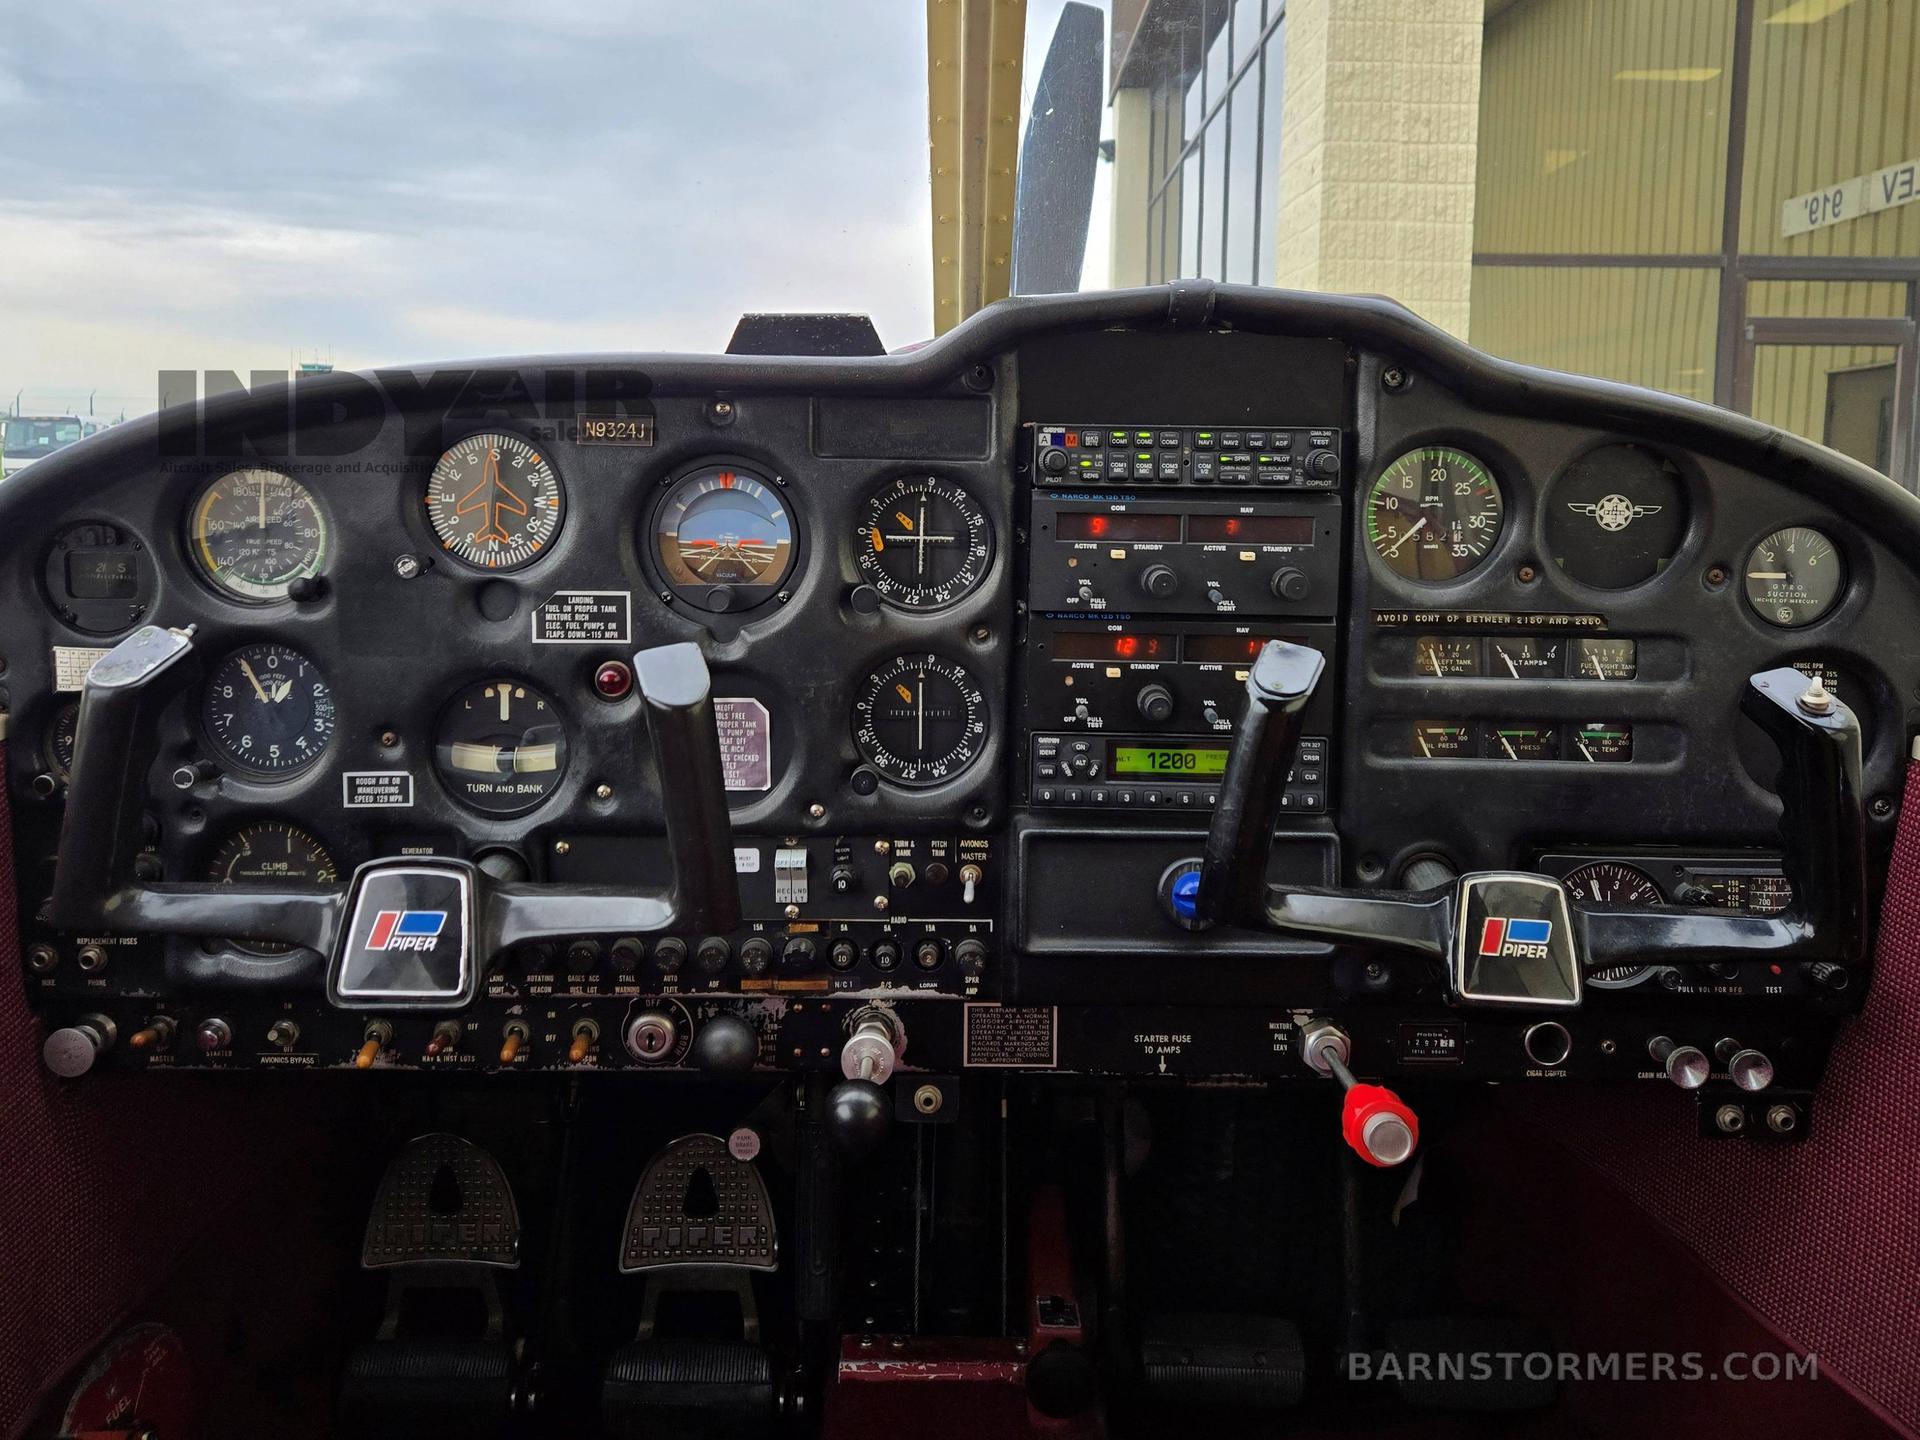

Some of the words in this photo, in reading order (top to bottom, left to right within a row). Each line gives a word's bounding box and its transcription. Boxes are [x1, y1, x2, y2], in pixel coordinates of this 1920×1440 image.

[585, 422, 645, 439] N9324J
[467, 453, 478, 466] 15
[490, 449, 501, 461] S
[511, 456, 525, 468] 21
[449, 468, 462, 482] 12
[527, 472, 541, 488] 24
[1430, 468, 1447, 482] 20
[896, 480, 904, 489] 6
[928, 476, 936, 486] 9
[1402, 476, 1414, 489] 15
[233, 487, 249, 497] 180
[1454, 482, 1472, 496] 25
[441, 493, 455, 503] E
[954, 488, 967, 501] 12
[290, 500, 305, 509] 60
[533, 495, 547, 509] W
[870, 498, 879, 507] 3
[1385, 497, 1398, 510] 10
[448, 515, 460, 526] 6
[526, 516, 542, 533] 30
[972, 513, 985, 526] 15
[1468, 515, 1486, 529] 30
[208, 520, 225, 531] 160
[304, 528, 318, 538] 80
[1388, 526, 1397, 538] 5
[465, 532, 477, 544] 3
[508, 533, 525, 549] 33
[488, 539, 499, 552] N
[976, 544, 987, 557] 18
[1451, 544, 1469, 557] 35
[1787, 543, 1795, 554] 4
[217, 556, 235, 567] 140
[1767, 552, 1774, 562] 2
[1808, 555, 1817, 566] 6
[568, 596, 594, 605] LANDING
[545, 605, 560, 613] FUEL
[562, 605, 572, 613] ON
[574, 605, 598, 613] PROPER
[601, 605, 617, 613] TANK
[545, 613, 572, 621] MIXTURE
[574, 613, 590, 621] RICH
[1377, 614, 1408, 622] AVOID
[1415, 614, 1441, 623] CONT
[1466, 615, 1510, 624] BETWEEN
[1516, 616, 1543, 625] 2150
[1549, 616, 1568, 625] AND
[1575, 617, 1601, 625] 2350
[545, 621, 563, 630] ELEC.
[565, 621, 581, 630] FUEL
[583, 621, 605, 630] PUMPS
[607, 622, 617, 630] ON
[545, 630, 565, 639] FLAPS
[604, 631, 619, 639] MPH
[267, 655, 278, 668] 0
[222, 685, 233, 698] 8
[313, 683, 324, 697] 2
[465, 701, 472, 709] L
[537, 701, 545, 710] R
[223, 713, 233, 727] 7
[313, 718, 325, 732] 3
[241, 735, 252, 748] 6
[295, 736, 307, 749] 4
[269, 745, 280, 758] 5
[733, 754, 760, 762] CHECKED
[1147, 752, 1196, 770] 1200
[355, 777, 376, 785] ROUGH
[379, 777, 389, 785] AIR
[392, 777, 401, 785] OR
[357, 786, 399, 794] MANEUVERING
[466, 783, 493, 793] TURN
[496, 785, 514, 793] AND
[517, 783, 543, 794] BANK
[354, 795, 374, 803] SPEED
[376, 795, 388, 803] 129
[389, 795, 403, 803] MPH
[931, 840, 947, 848] PITCH
[959, 840, 989, 848] AVIONICS
[401, 847, 434, 855] GENERATOR
[896, 848, 912, 857] BANK
[931, 848, 945, 857] TRIM
[961, 852, 987, 861] MASTER
[261, 862, 288, 871] CLIMB
[1573, 889, 1585, 899] 33
[890, 916, 907, 924] RADIO
[76, 937, 117, 945] REPLACEMENT
[119, 937, 138, 945] FUSES
[388, 936, 438, 952] PIPER
[1502, 943, 1548, 959] PIPER
[87, 979, 107, 987] PHONE
[526, 975, 554, 983] ROTATING
[618, 975, 635, 983] STALL
[663, 975, 678, 983] AUTO
[708, 980, 721, 988] ADF
[965, 976, 979, 984] SPKR
[615, 986, 640, 994] WARNING
[645, 998, 661, 1008] OFF
[1134, 1034, 1170, 1043] STARTER
[1172, 1034, 1192, 1043] FUSE
[1274, 1033, 1287, 1041] PULL
[205, 1050, 233, 1058] STARTER
[1144, 1046, 1154, 1054] 10
[1157, 1046, 1181, 1054] AMPS
[150, 1055, 175, 1063] MASTER
[260, 1056, 289, 1064] AVIONICS
[290, 1057, 315, 1065] BYPASS
[642, 1225, 758, 1247] PIPER
